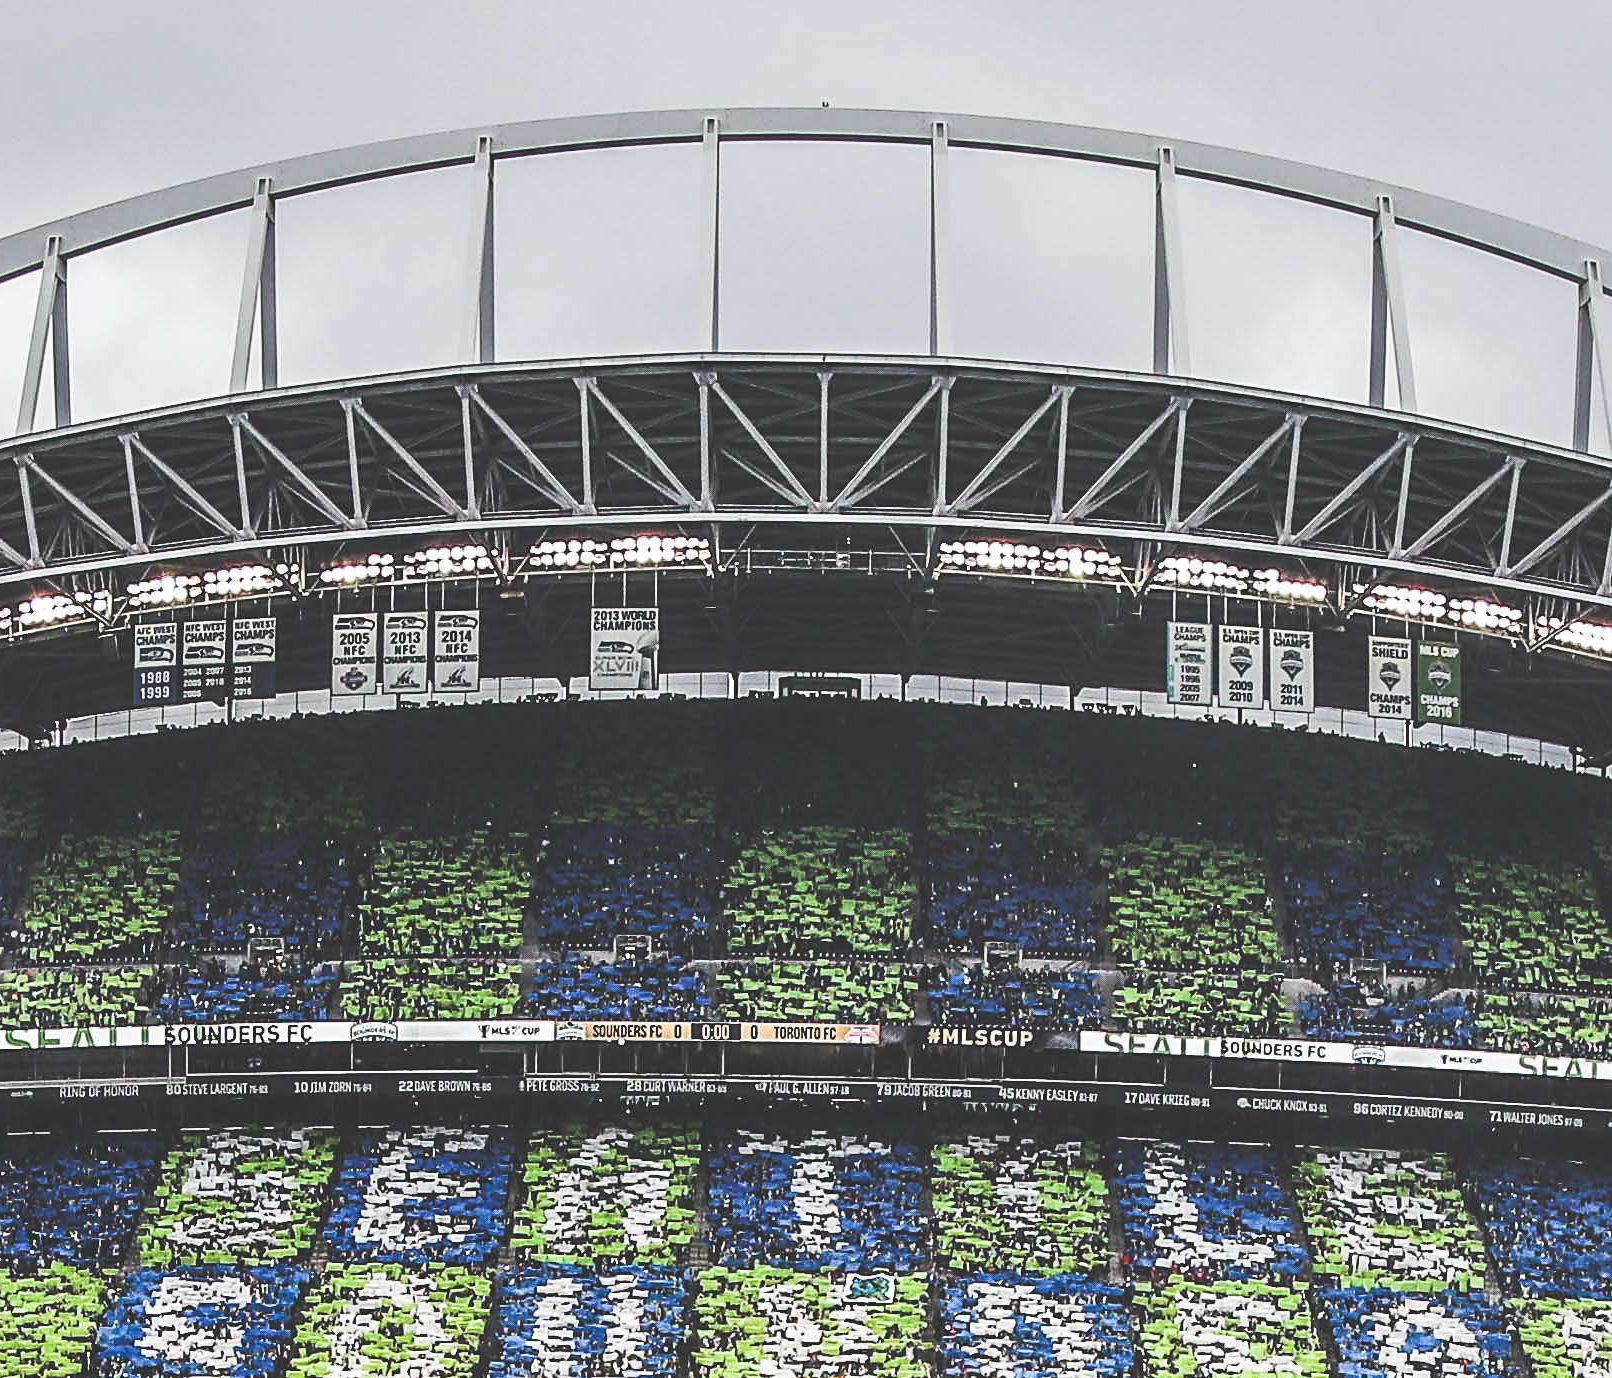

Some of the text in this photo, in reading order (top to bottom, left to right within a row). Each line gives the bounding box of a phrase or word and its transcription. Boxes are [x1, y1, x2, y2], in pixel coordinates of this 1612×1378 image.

[594, 610, 656, 621] 2013 WORLD
[153, 625, 175, 634] WEST
[203, 622, 225, 631] WEST
[252, 620, 275, 629] WEST
[593, 620, 656, 631] CHAMPIONS
[1175, 625, 1204, 634] LEAGUE
[136, 634, 176, 646] CHAMPS
[185, 632, 225, 643] CHAMPS
[234, 629, 275, 641] CHAMPS
[339, 632, 370, 645] 2005
[390, 631, 421, 645] 2013
[441, 630, 472, 643] 2014
[1174, 633, 1206, 642] CHAMPS
[1222, 635, 1260, 645] CHAMPS
[394, 644, 417, 655] NFC
[445, 643, 469, 653] NFC
[1273, 638, 1310, 649] CHAMPS
[343, 645, 366, 656] NFC
[1372, 647, 1408, 659] SHIELD
[1420, 645, 1459, 658] MLS CUP
[593, 660, 639, 672] XLVIII
[140, 671, 170, 684] 1988
[1229, 681, 1254, 691] 2009
[1280, 684, 1303, 695] 2011
[140, 686, 170, 699] 1999
[1229, 692, 1253, 703] 2010
[1280, 695, 1304, 706] 2014
[1370, 693, 1410, 705] CHAMPS
[1420, 694, 1459, 707] CHAMPS
[1379, 704, 1401, 714] 2014
[1427, 705, 1452, 718] 2016
[164, 1024, 313, 1046] SOUNDERS FC
[521, 1026, 540, 1035] CUP
[592, 1025, 663, 1039] SOUNDERS FC
[674, 1025, 682, 1039] 0
[701, 1025, 730, 1040] 0:00
[750, 1026, 758, 1040] 0
[774, 1026, 837, 1041] TORONTO FC
[927, 1029, 1033, 1047] #MLSCUP
[1220, 1039, 1326, 1059] SOUNDERS FC
[60, 1084, 138, 1098] RING OF HONOR
[166, 1082, 247, 1096] 80 STEVE LARGENT
[294, 1081, 351, 1094] 10 JIM ZORN
[398, 1080, 470, 1092] 22 DAVE BROWN
[526, 1080, 579, 1092] PETE GROSS
[626, 1081, 705, 1093] 28 CURT WARNER
[802, 1083, 829, 1095] ALLEN
[877, 1083, 952, 1097] 79 JACOB GREEN
[999, 1087, 1078, 1102] 45 KENNY EASLEY
[1124, 1092, 1190, 1106] 17 DAVE KRIEG
[1252, 1098, 1307, 1112] CHUCK KNOX
[1353, 1102, 1443, 1119] 96 CORTEZ KENNEDY
[1489, 1110, 1563, 1126] 71 WALTER JONES
